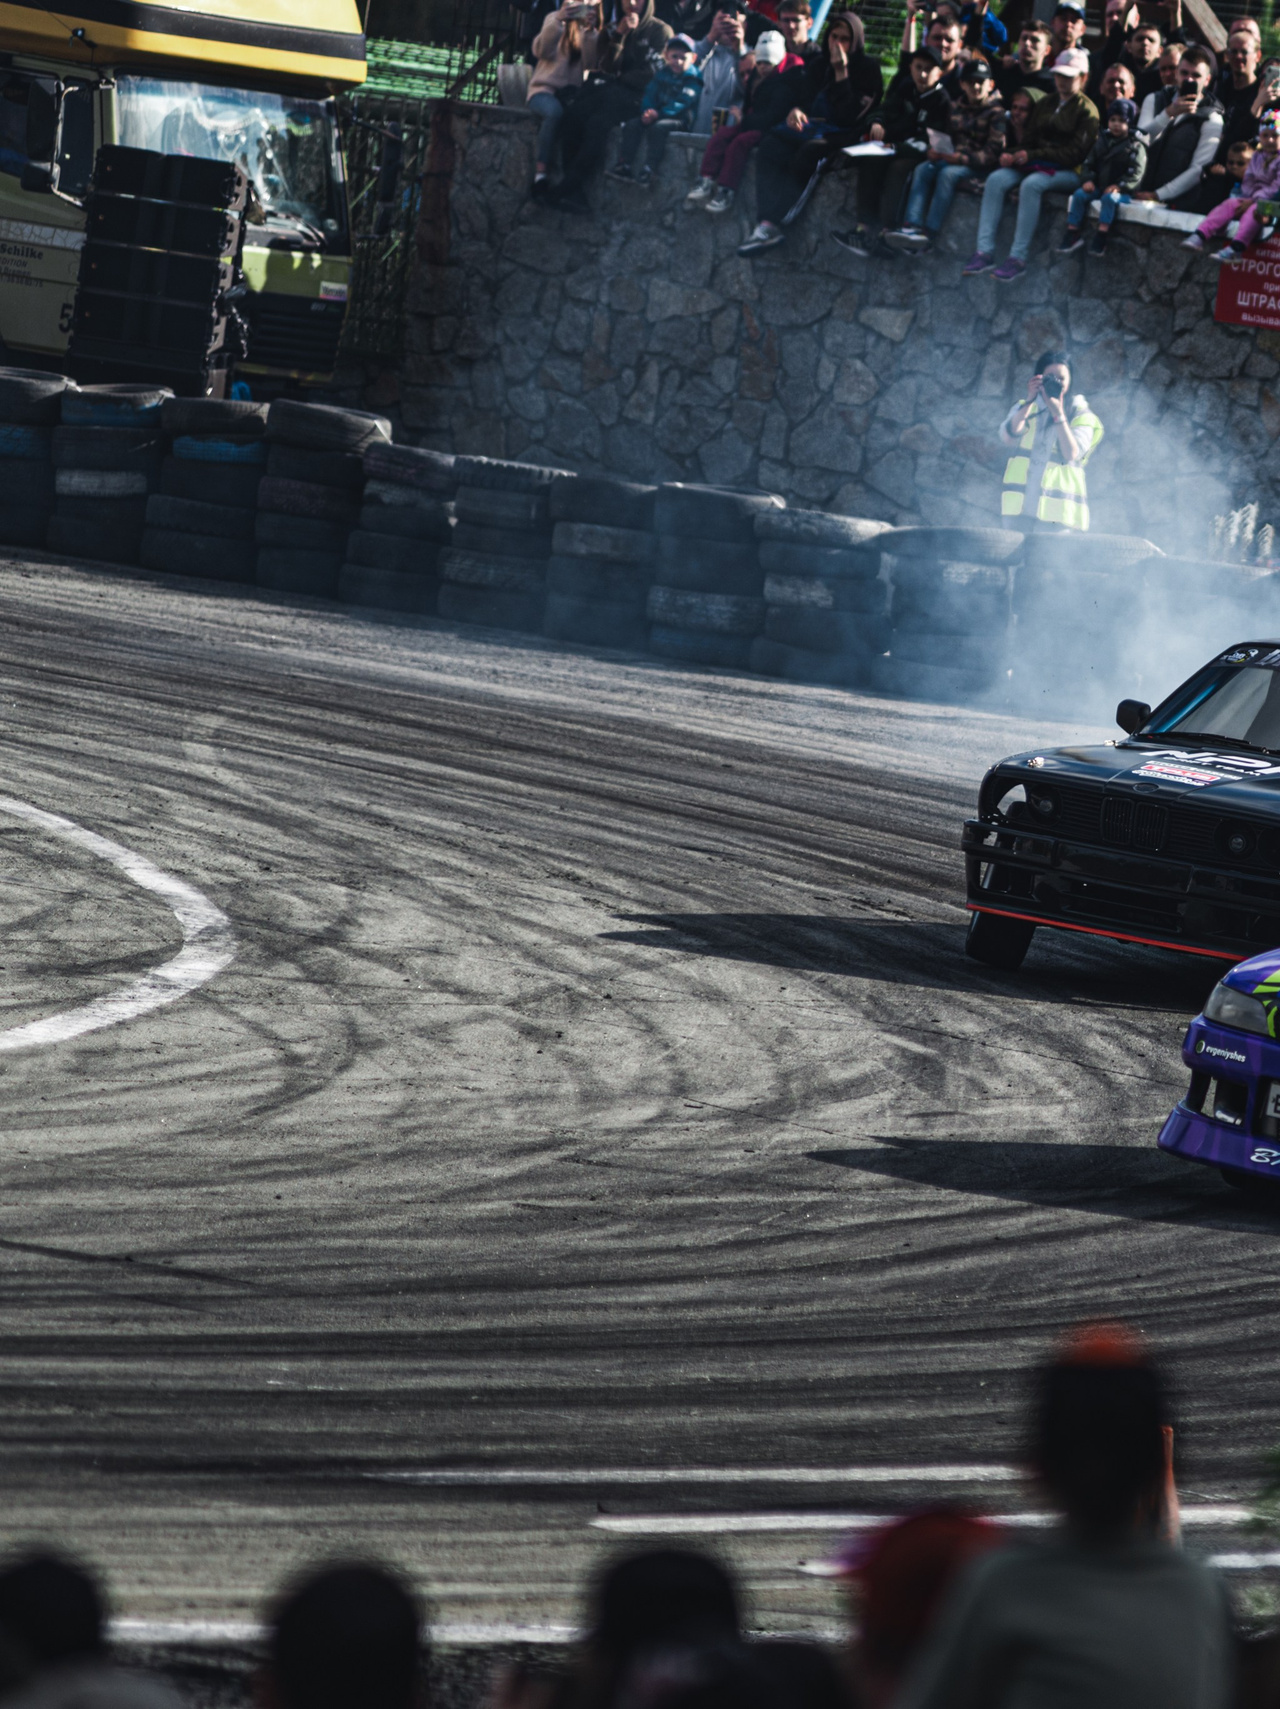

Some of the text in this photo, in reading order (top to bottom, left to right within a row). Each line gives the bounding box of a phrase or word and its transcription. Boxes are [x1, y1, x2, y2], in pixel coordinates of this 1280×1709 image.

[0, 243, 43, 260] Schilke
[0, 257, 28, 268] DITION
[1263, 282, 1280, 293] при
